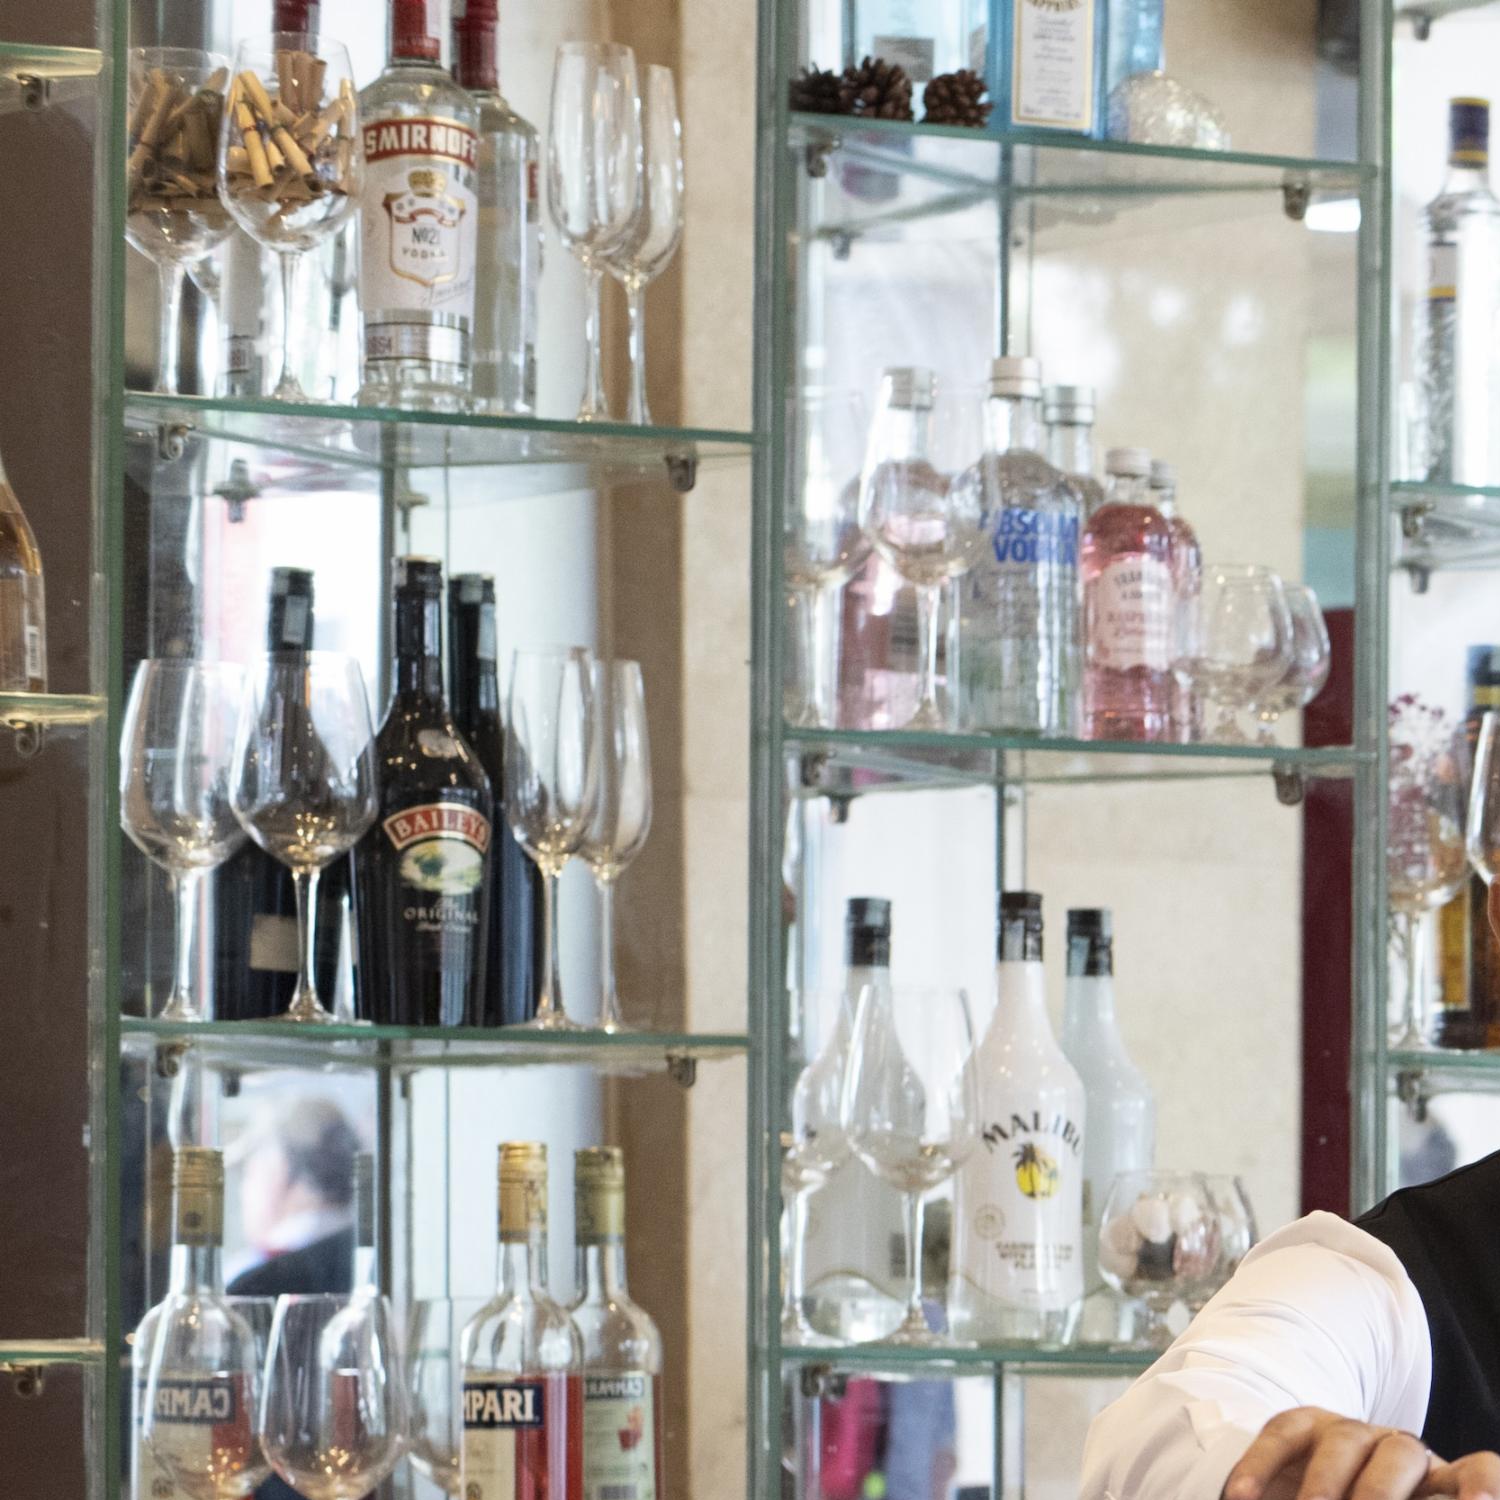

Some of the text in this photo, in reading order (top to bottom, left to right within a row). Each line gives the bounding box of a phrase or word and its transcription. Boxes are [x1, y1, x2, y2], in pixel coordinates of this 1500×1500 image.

[394, 810, 486, 842] BAILEYS
[403, 906, 479, 925] ORIGINAL
[463, 1388, 534, 1423] MPARI
